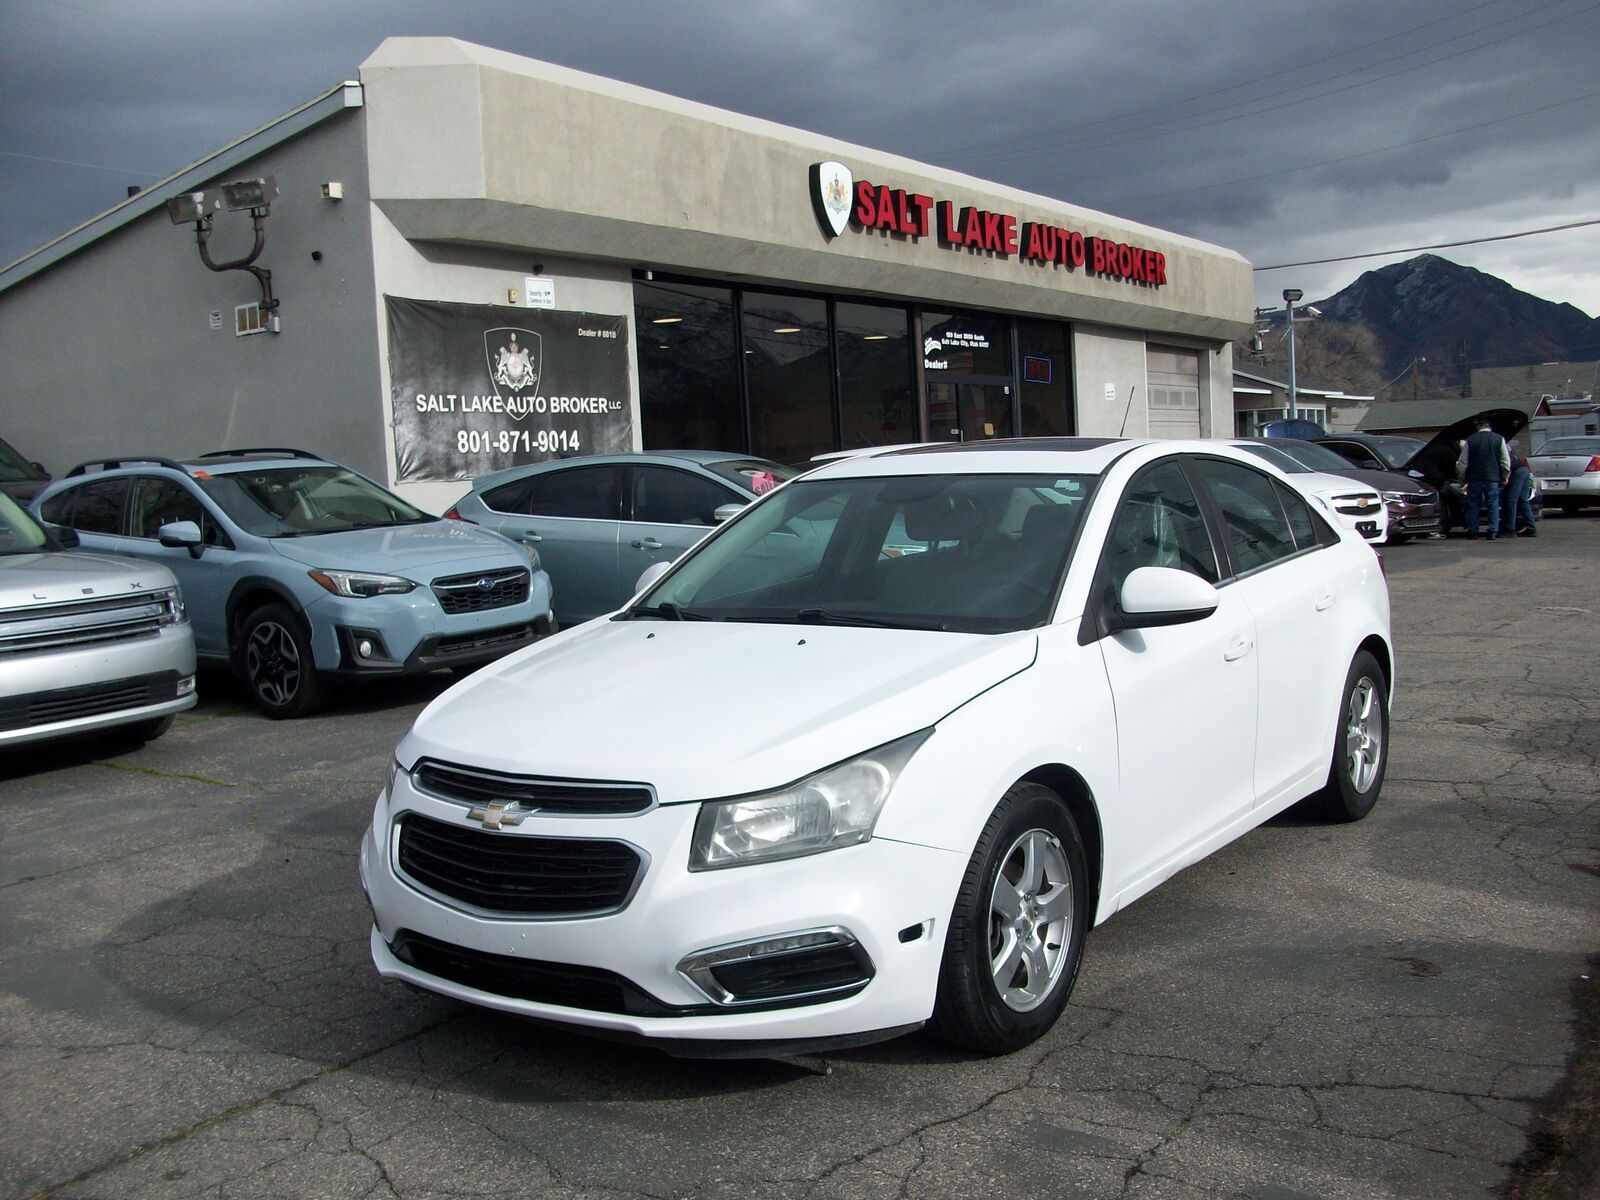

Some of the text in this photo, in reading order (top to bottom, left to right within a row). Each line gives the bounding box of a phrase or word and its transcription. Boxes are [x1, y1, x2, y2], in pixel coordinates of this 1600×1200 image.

[856, 180, 1167, 286] SALT LAKE AUTO BROKER
[578, 328, 596, 337] Dealer
[416, 394, 622, 414] SALT LAKE AUTO BROKER LLC
[457, 430, 580, 454] 801-871-9014
